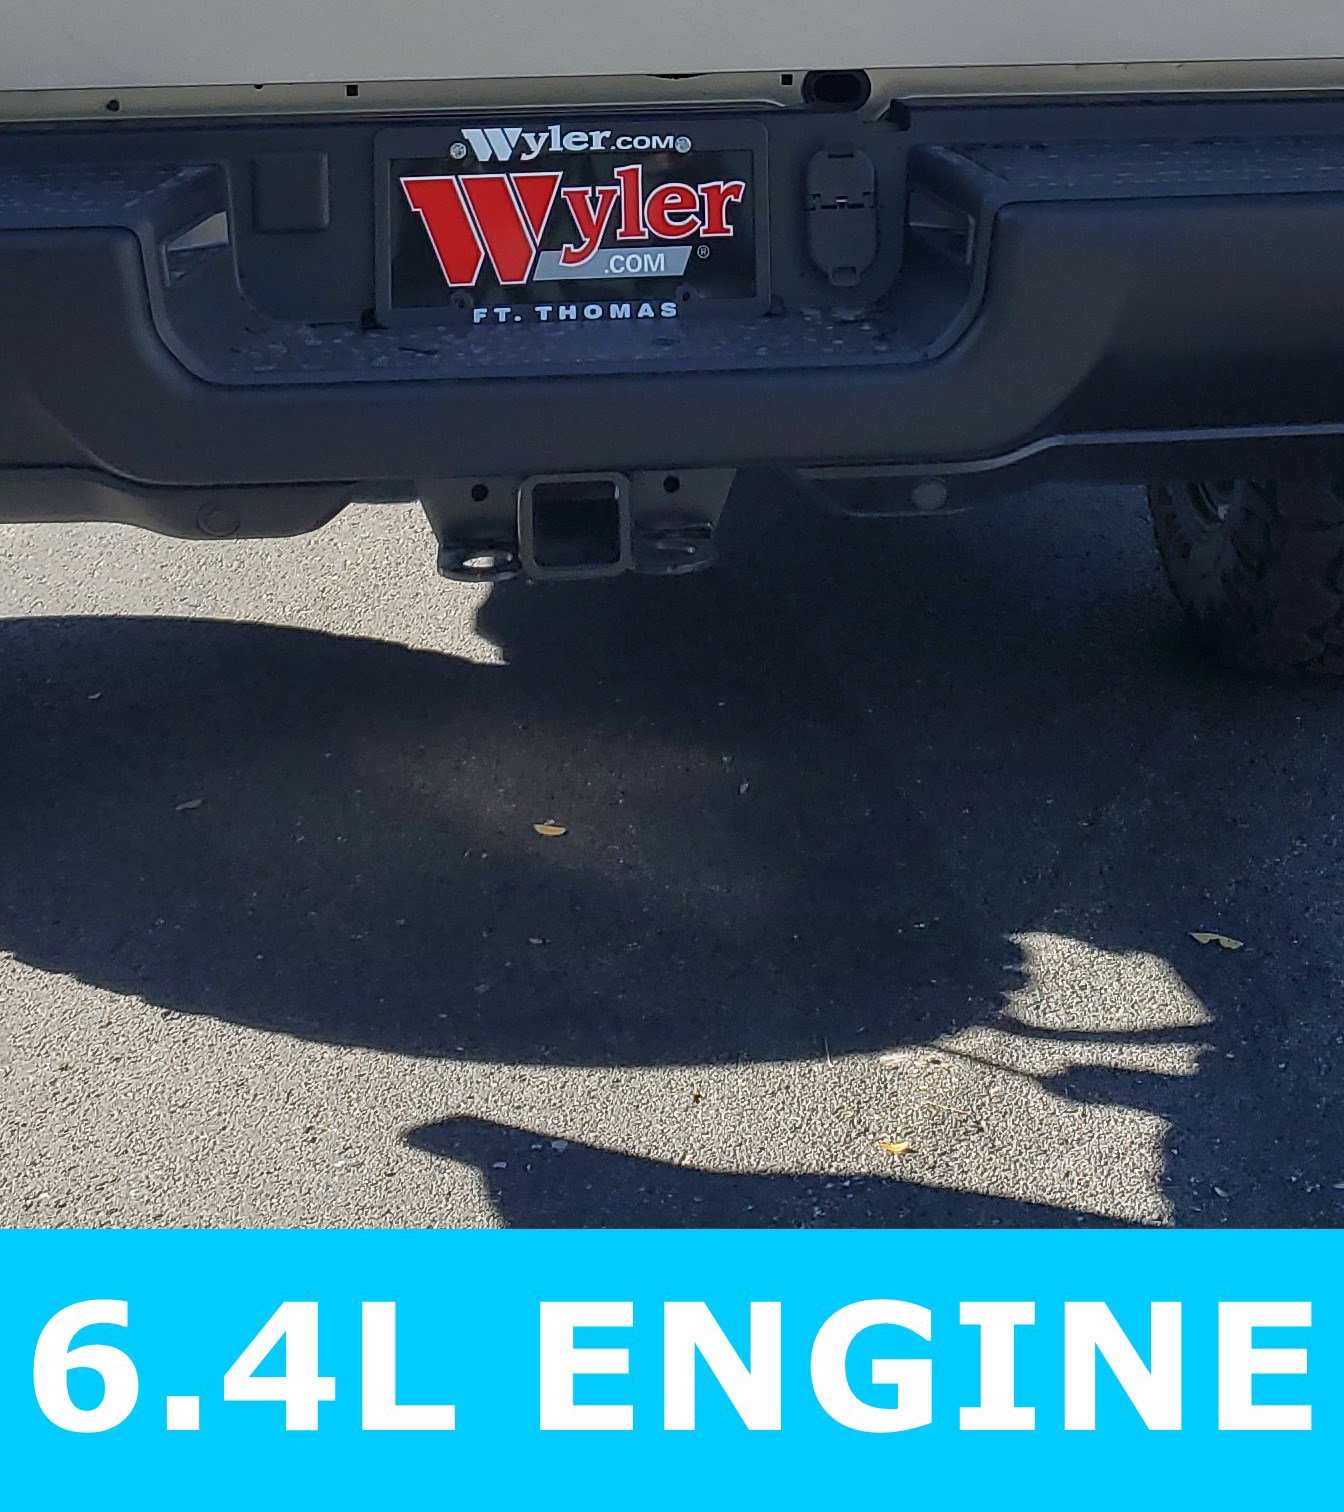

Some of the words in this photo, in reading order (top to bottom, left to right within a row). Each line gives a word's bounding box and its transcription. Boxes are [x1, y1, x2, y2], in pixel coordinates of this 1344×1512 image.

[400, 164, 745, 287] Wyler
[605, 253, 665, 274] .COM
[473, 308, 522, 323] FT.
[535, 302, 677, 320] THOMAS
